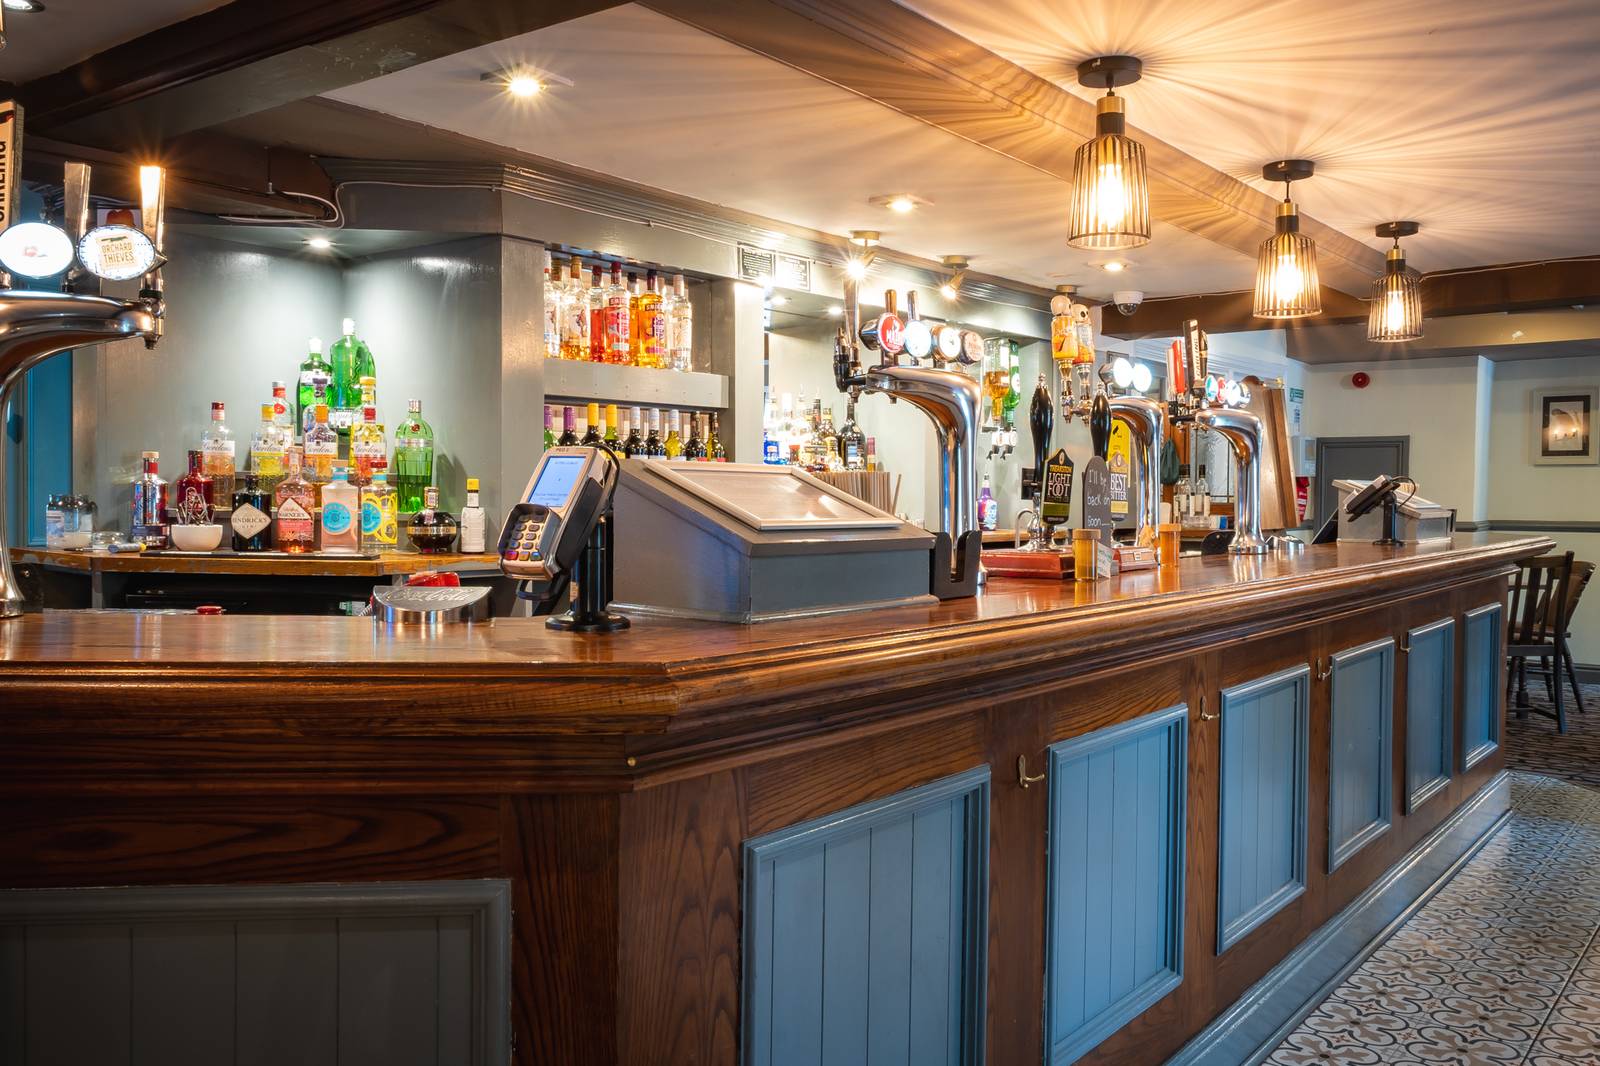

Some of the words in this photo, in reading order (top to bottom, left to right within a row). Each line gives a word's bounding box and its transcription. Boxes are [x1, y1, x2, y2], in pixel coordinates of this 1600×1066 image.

[101, 241, 133, 254] ORCHARD
[103, 252, 135, 265] THIEVES
[1048, 472, 1072, 484] LIGHT
[1110, 473, 1127, 491] BEST
[1047, 482, 1070, 497] FOOT
